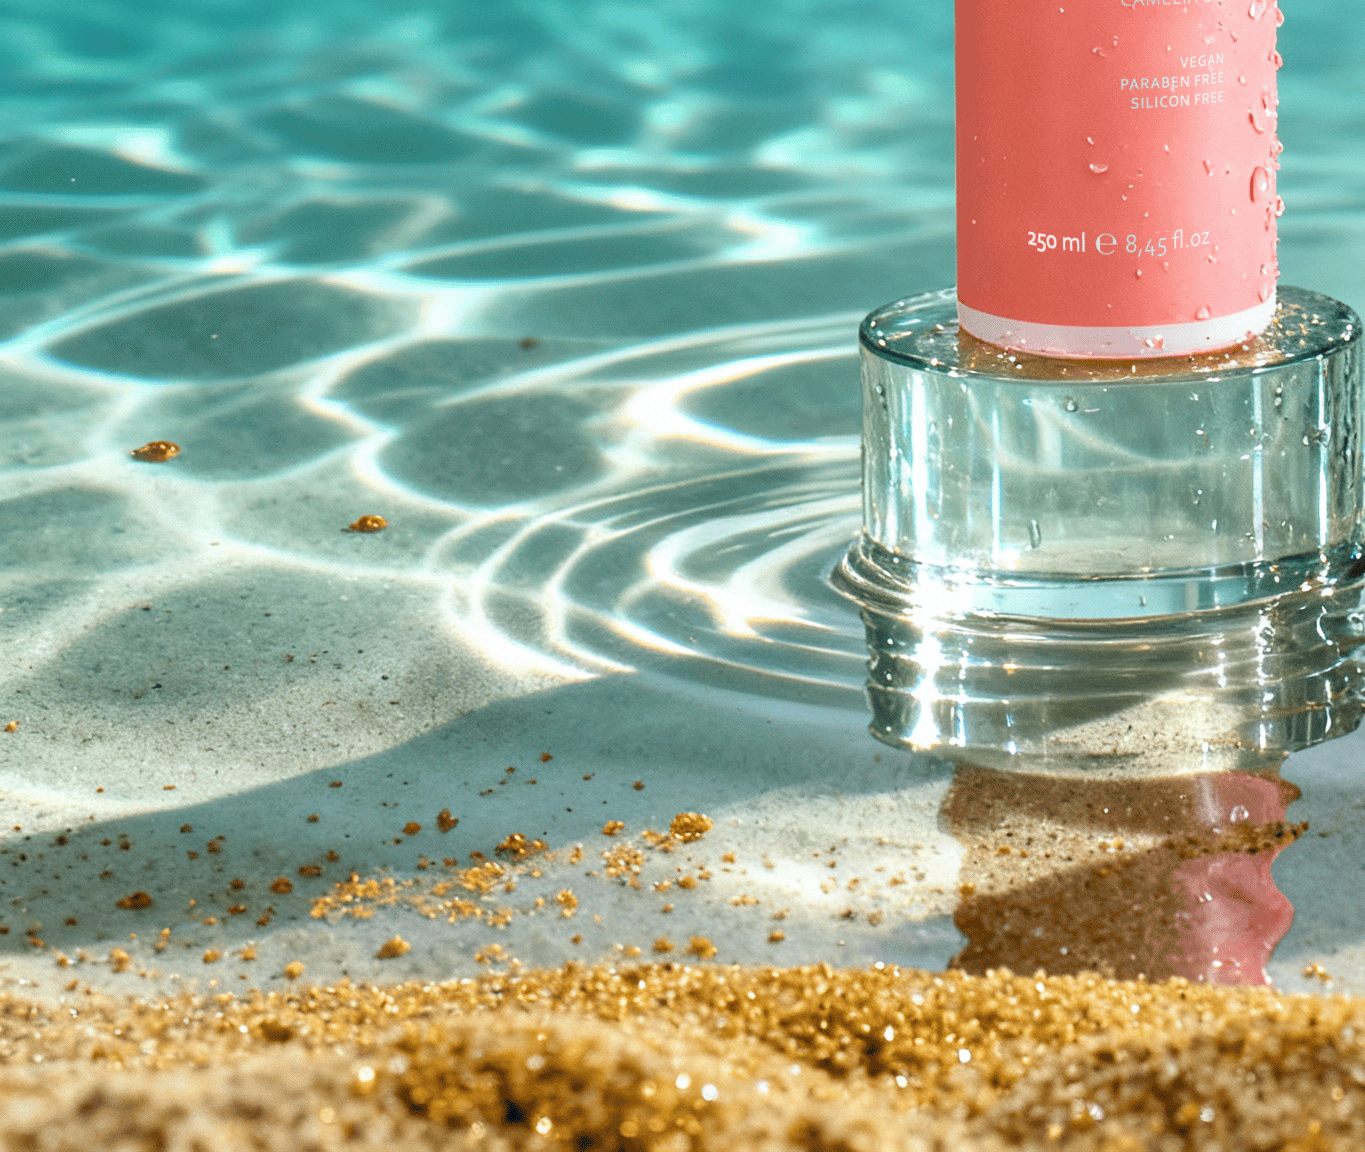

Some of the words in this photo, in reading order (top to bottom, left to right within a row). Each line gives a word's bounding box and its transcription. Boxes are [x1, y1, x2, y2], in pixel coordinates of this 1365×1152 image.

[1180, 53, 1224, 68] VEGAN
[1121, 76, 1189, 90] PARABEN
[1194, 71, 1224, 87] FREE
[1131, 94, 1190, 109] SILICON
[1194, 90, 1224, 106] FREE
[1028, 231, 1057, 252] 250
[1062, 232, 1085, 253] ml
[1126, 234, 1167, 258] 8,45
